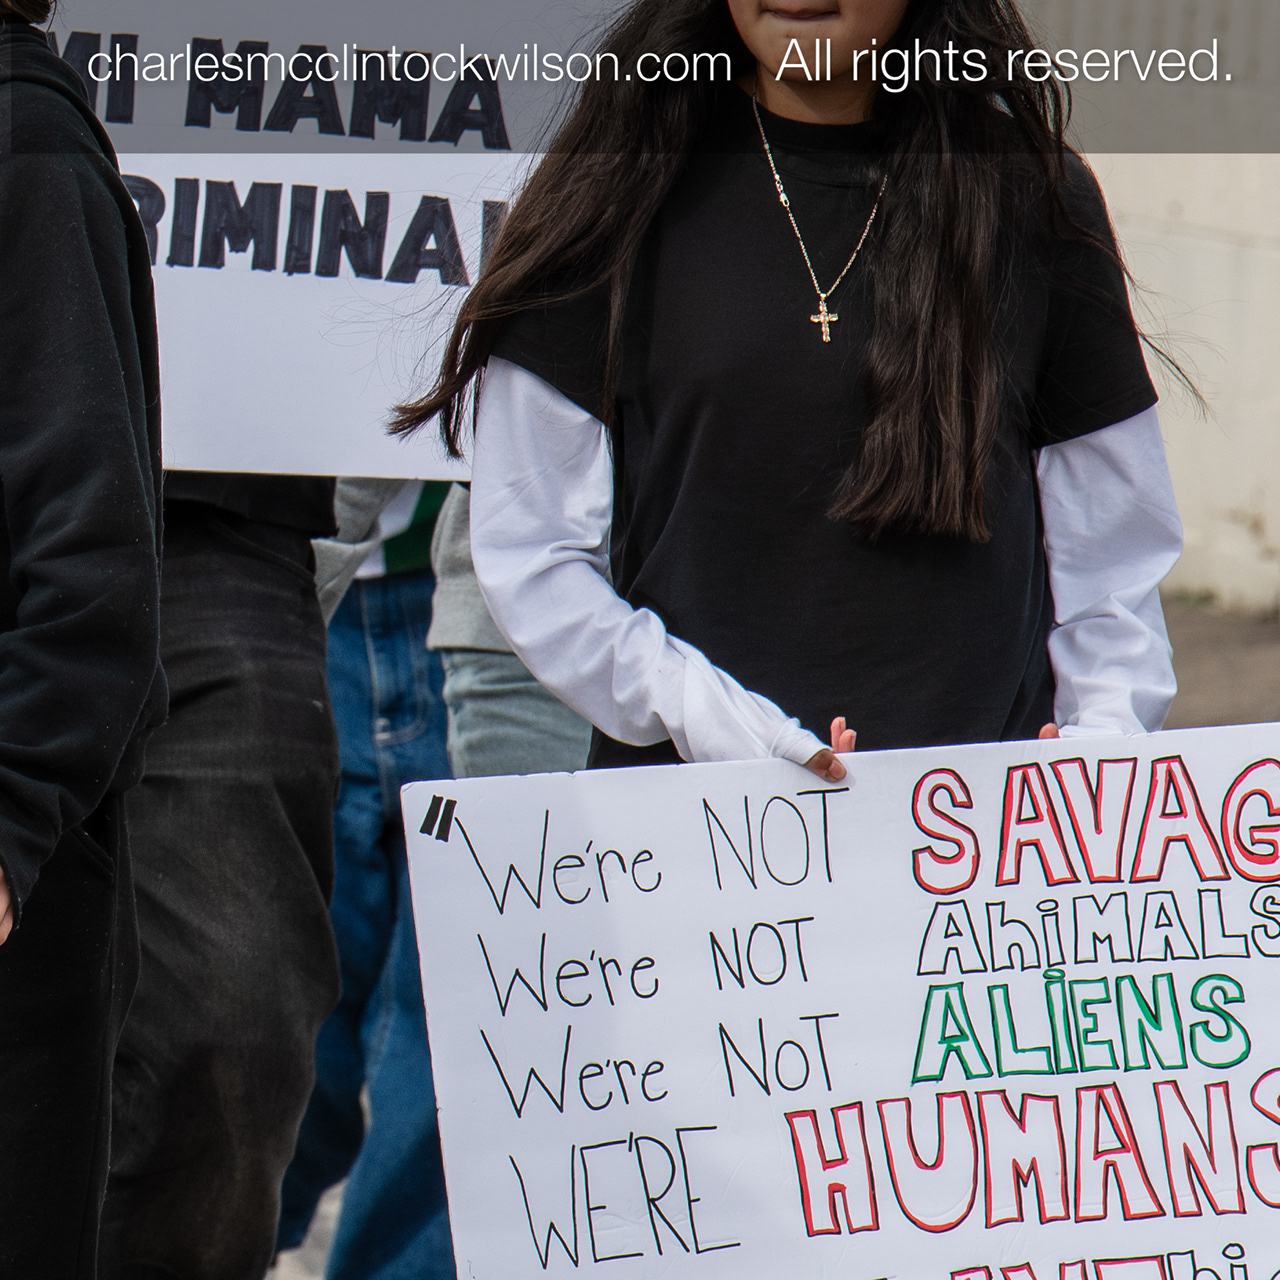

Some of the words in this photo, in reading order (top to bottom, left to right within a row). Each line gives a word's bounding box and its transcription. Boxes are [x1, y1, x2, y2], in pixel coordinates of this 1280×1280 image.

[183, 36, 512, 151] MAMA
[702, 787, 850, 892] NOT
[477, 932, 659, 1017] We're
[709, 916, 815, 991] NOT
